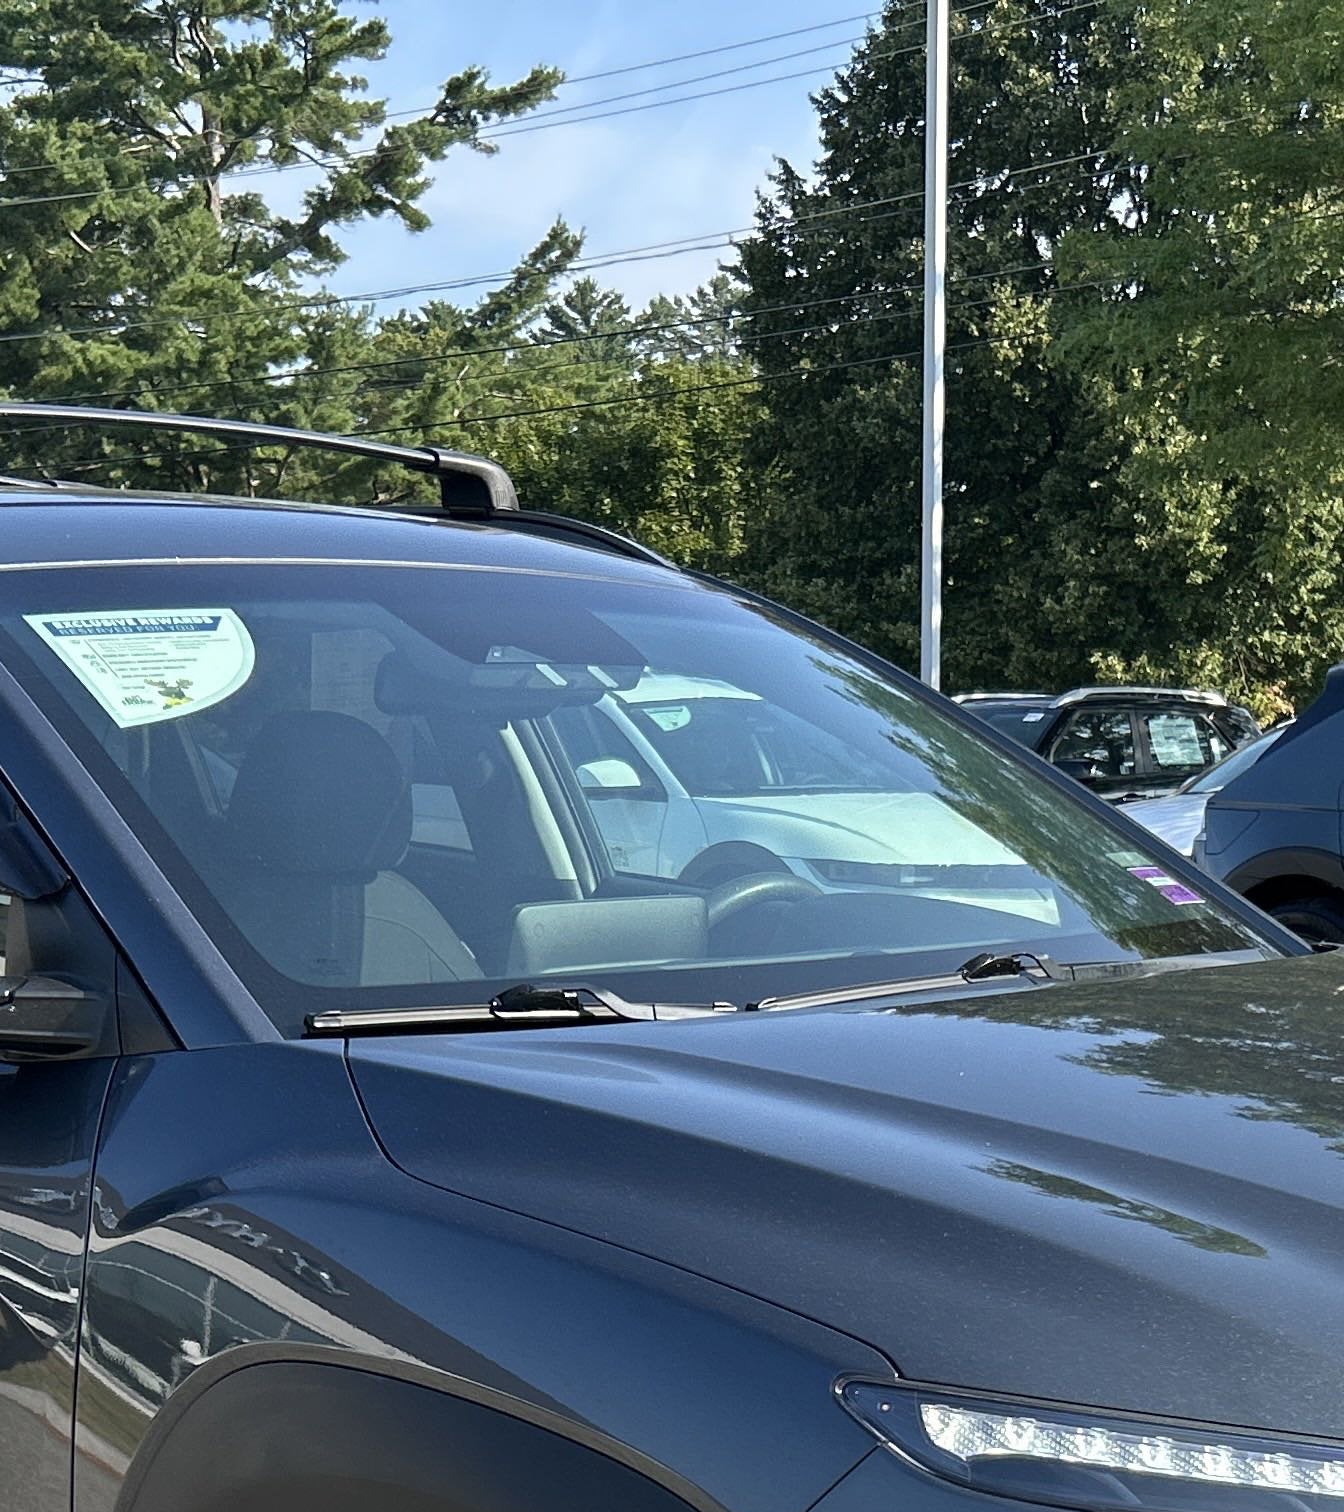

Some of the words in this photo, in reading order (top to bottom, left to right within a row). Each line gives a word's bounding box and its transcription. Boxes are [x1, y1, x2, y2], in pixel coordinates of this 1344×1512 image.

[51, 617, 136, 629] EXCLUSIVE
[137, 615, 214, 626] REWARDS
[58, 626, 133, 636] RESERVED
[136, 624, 165, 634] FOR
